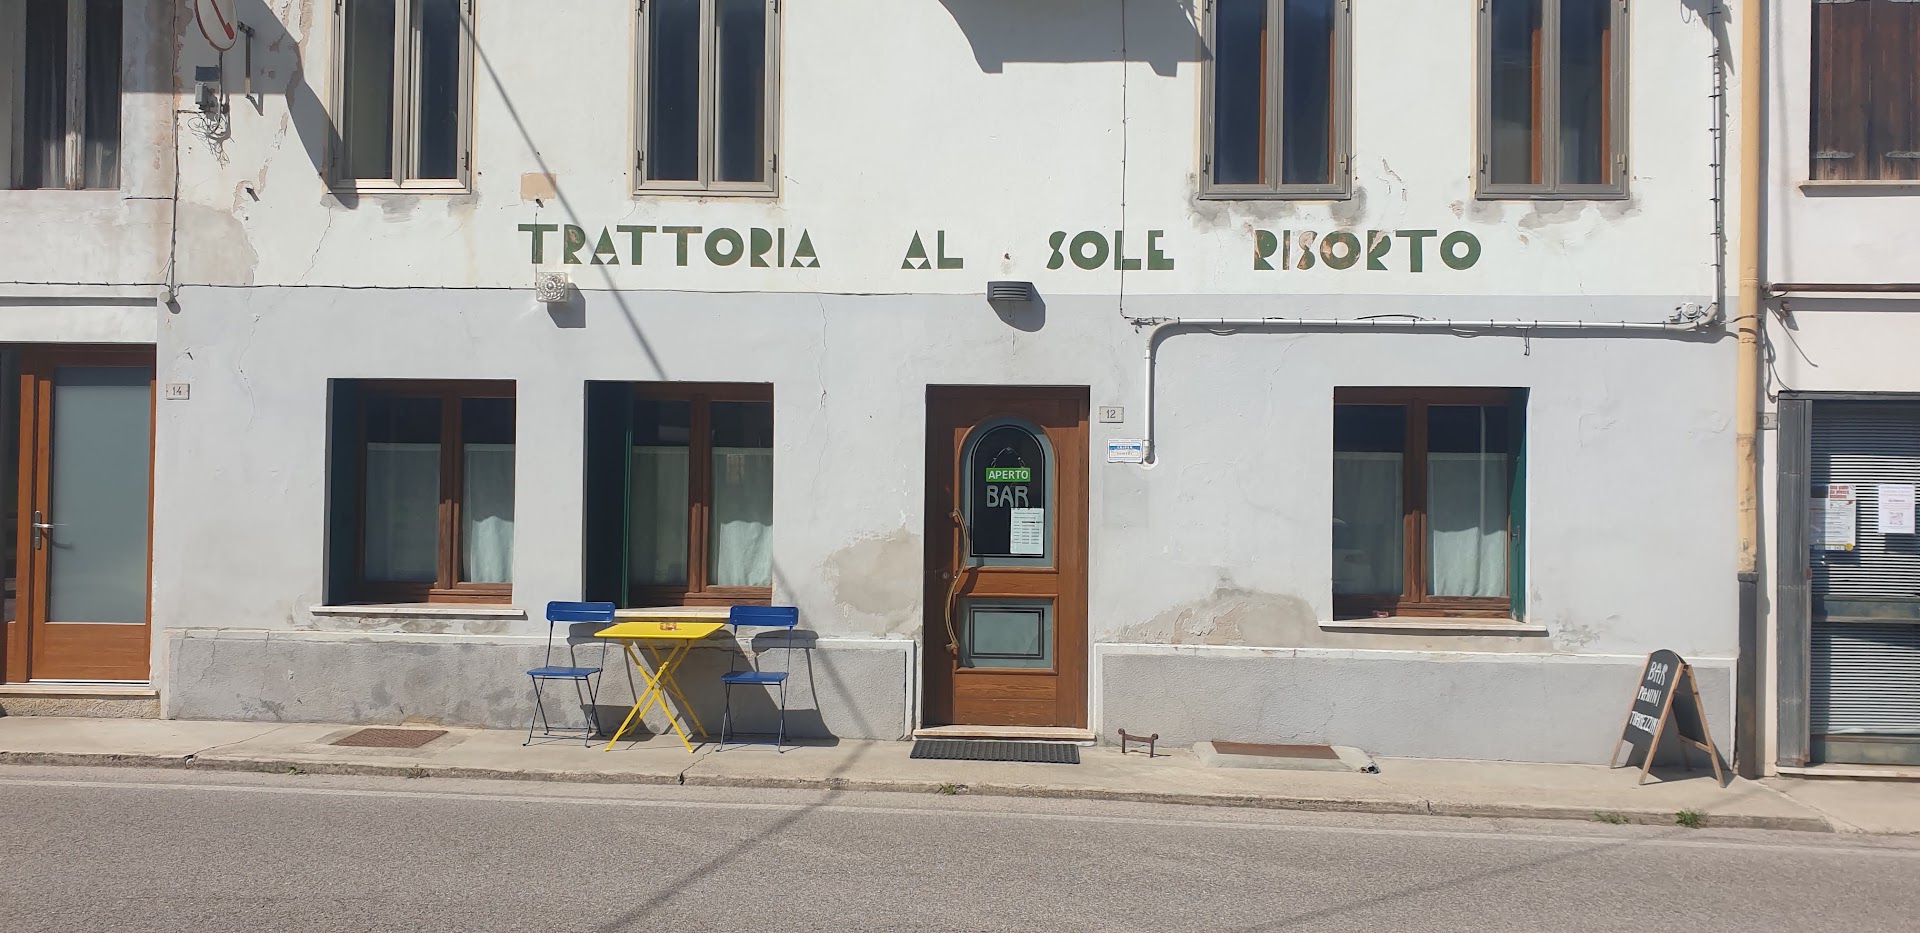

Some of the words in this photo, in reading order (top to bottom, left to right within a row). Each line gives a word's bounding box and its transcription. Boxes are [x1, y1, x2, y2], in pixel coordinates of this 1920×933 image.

[518, 224, 821, 268] TRATTORIA
[901, 229, 964, 270] AL
[1046, 229, 1175, 271] SOLE
[1253, 229, 1482, 273] RISORTO
[172, 386, 182, 396] 14
[1106, 409, 1116, 419] 12
[988, 469, 1029, 480] APERTO
[986, 484, 1030, 508] BAR
[1646, 661, 1669, 686] BAR
